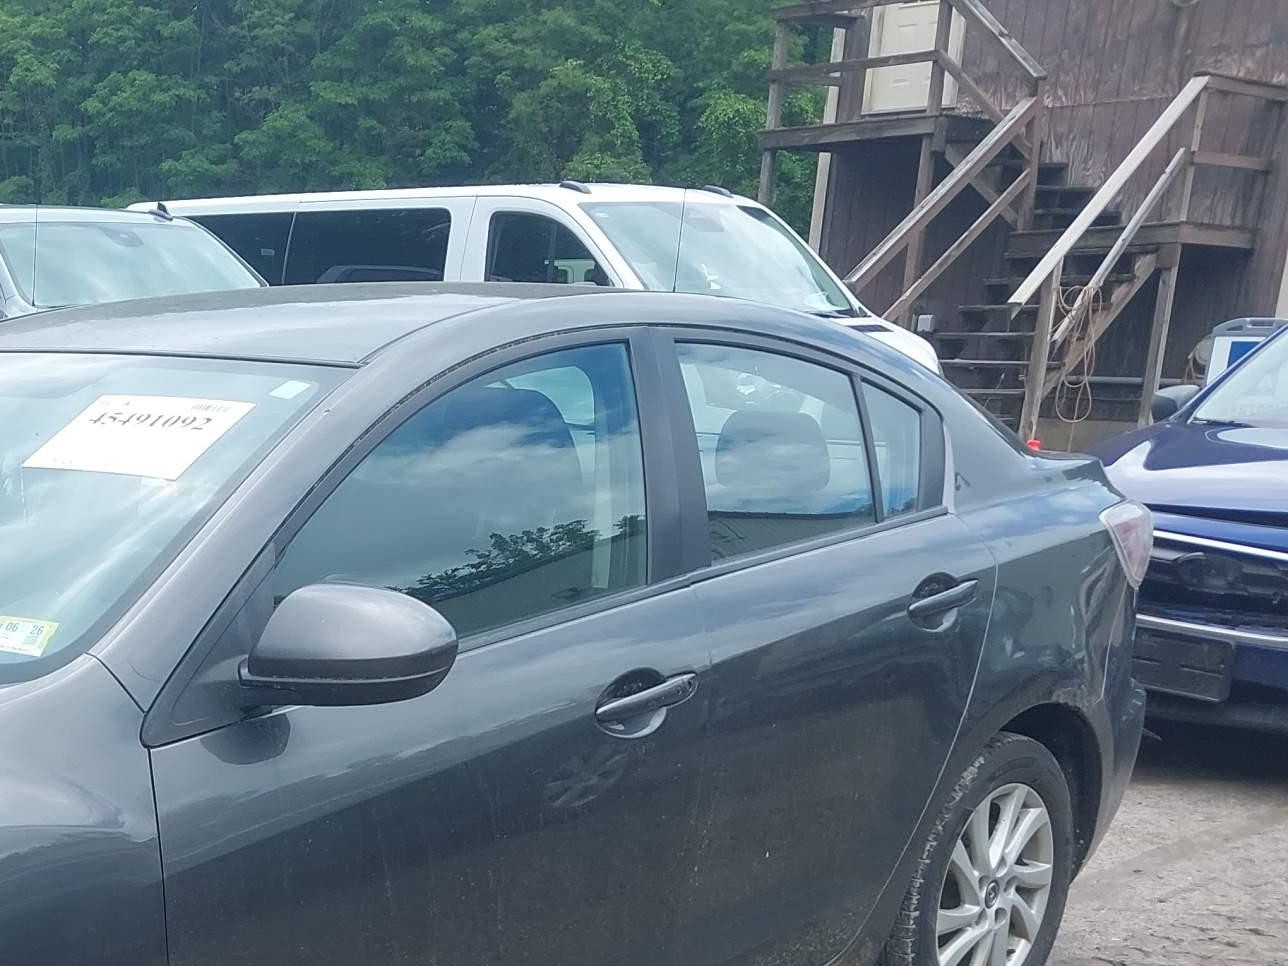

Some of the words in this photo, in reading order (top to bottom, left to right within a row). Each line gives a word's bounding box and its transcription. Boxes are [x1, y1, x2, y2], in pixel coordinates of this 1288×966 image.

[89, 411, 213, 431] 45491092
[5, 622, 20, 632] 06
[30, 624, 45, 636] 26
